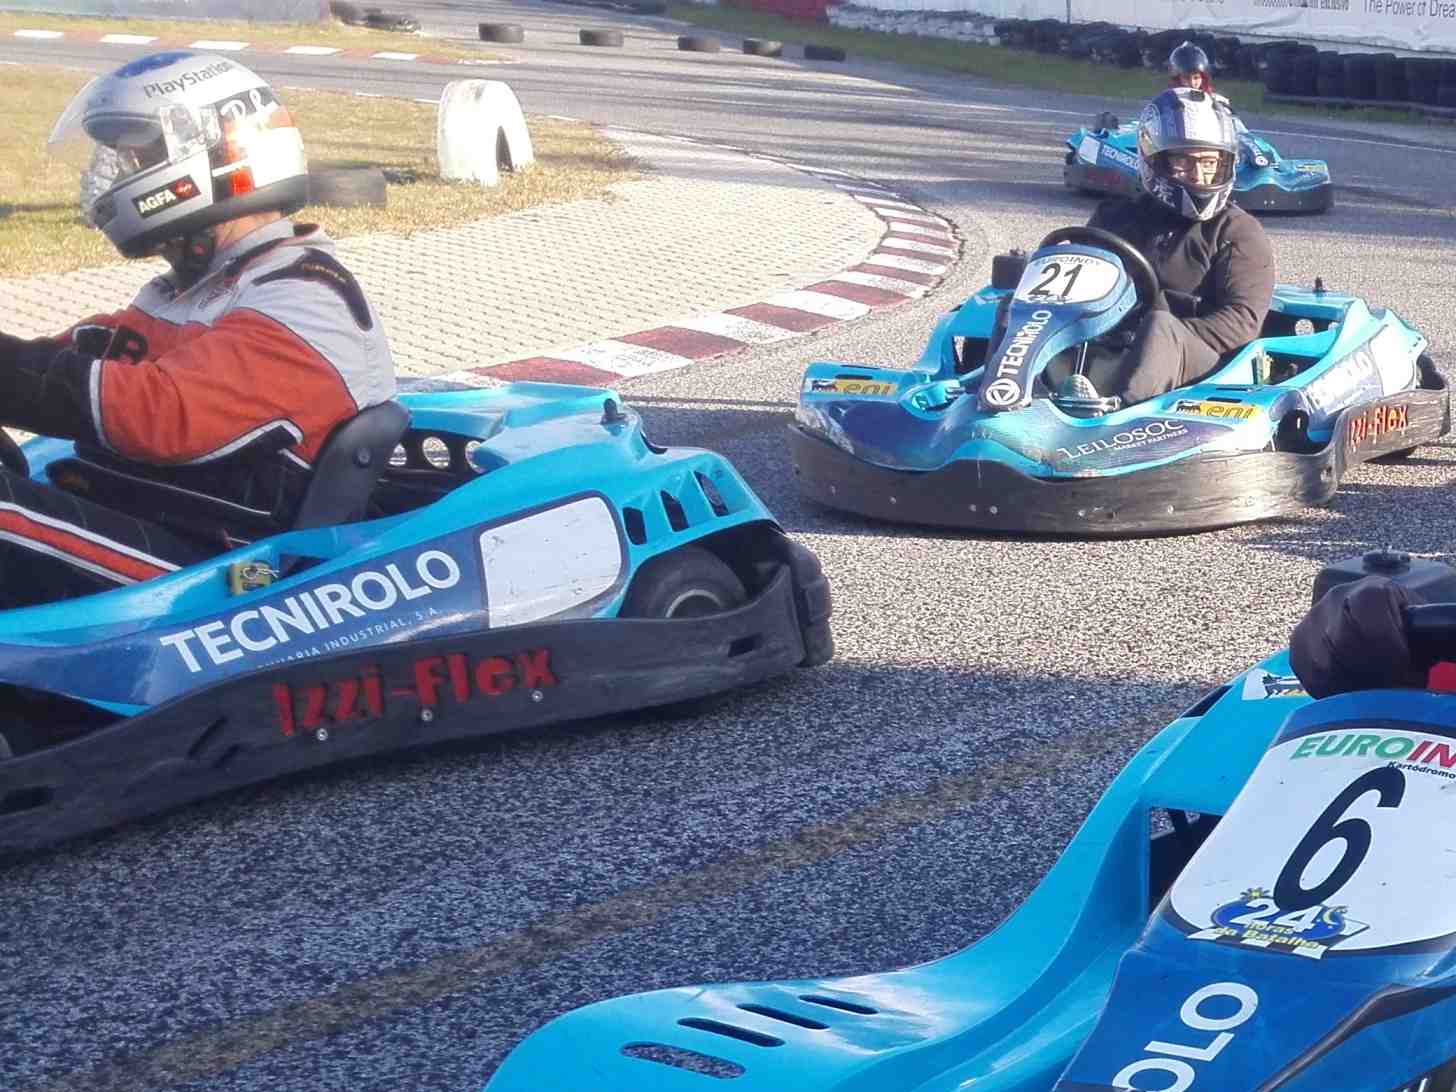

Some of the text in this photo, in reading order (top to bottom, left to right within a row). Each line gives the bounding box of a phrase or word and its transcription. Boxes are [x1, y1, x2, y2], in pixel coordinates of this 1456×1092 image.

[143, 59, 237, 99] PlayStation
[137, 189, 177, 214] AGFA
[1028, 262, 1083, 297] 21
[1056, 419, 1185, 459] LEILOSOC
[159, 549, 461, 673] TECNIROLO
[1387, 760, 1456, 780] Kartódromo
[1273, 765, 1407, 911] 6
[1229, 897, 1326, 934] 24
